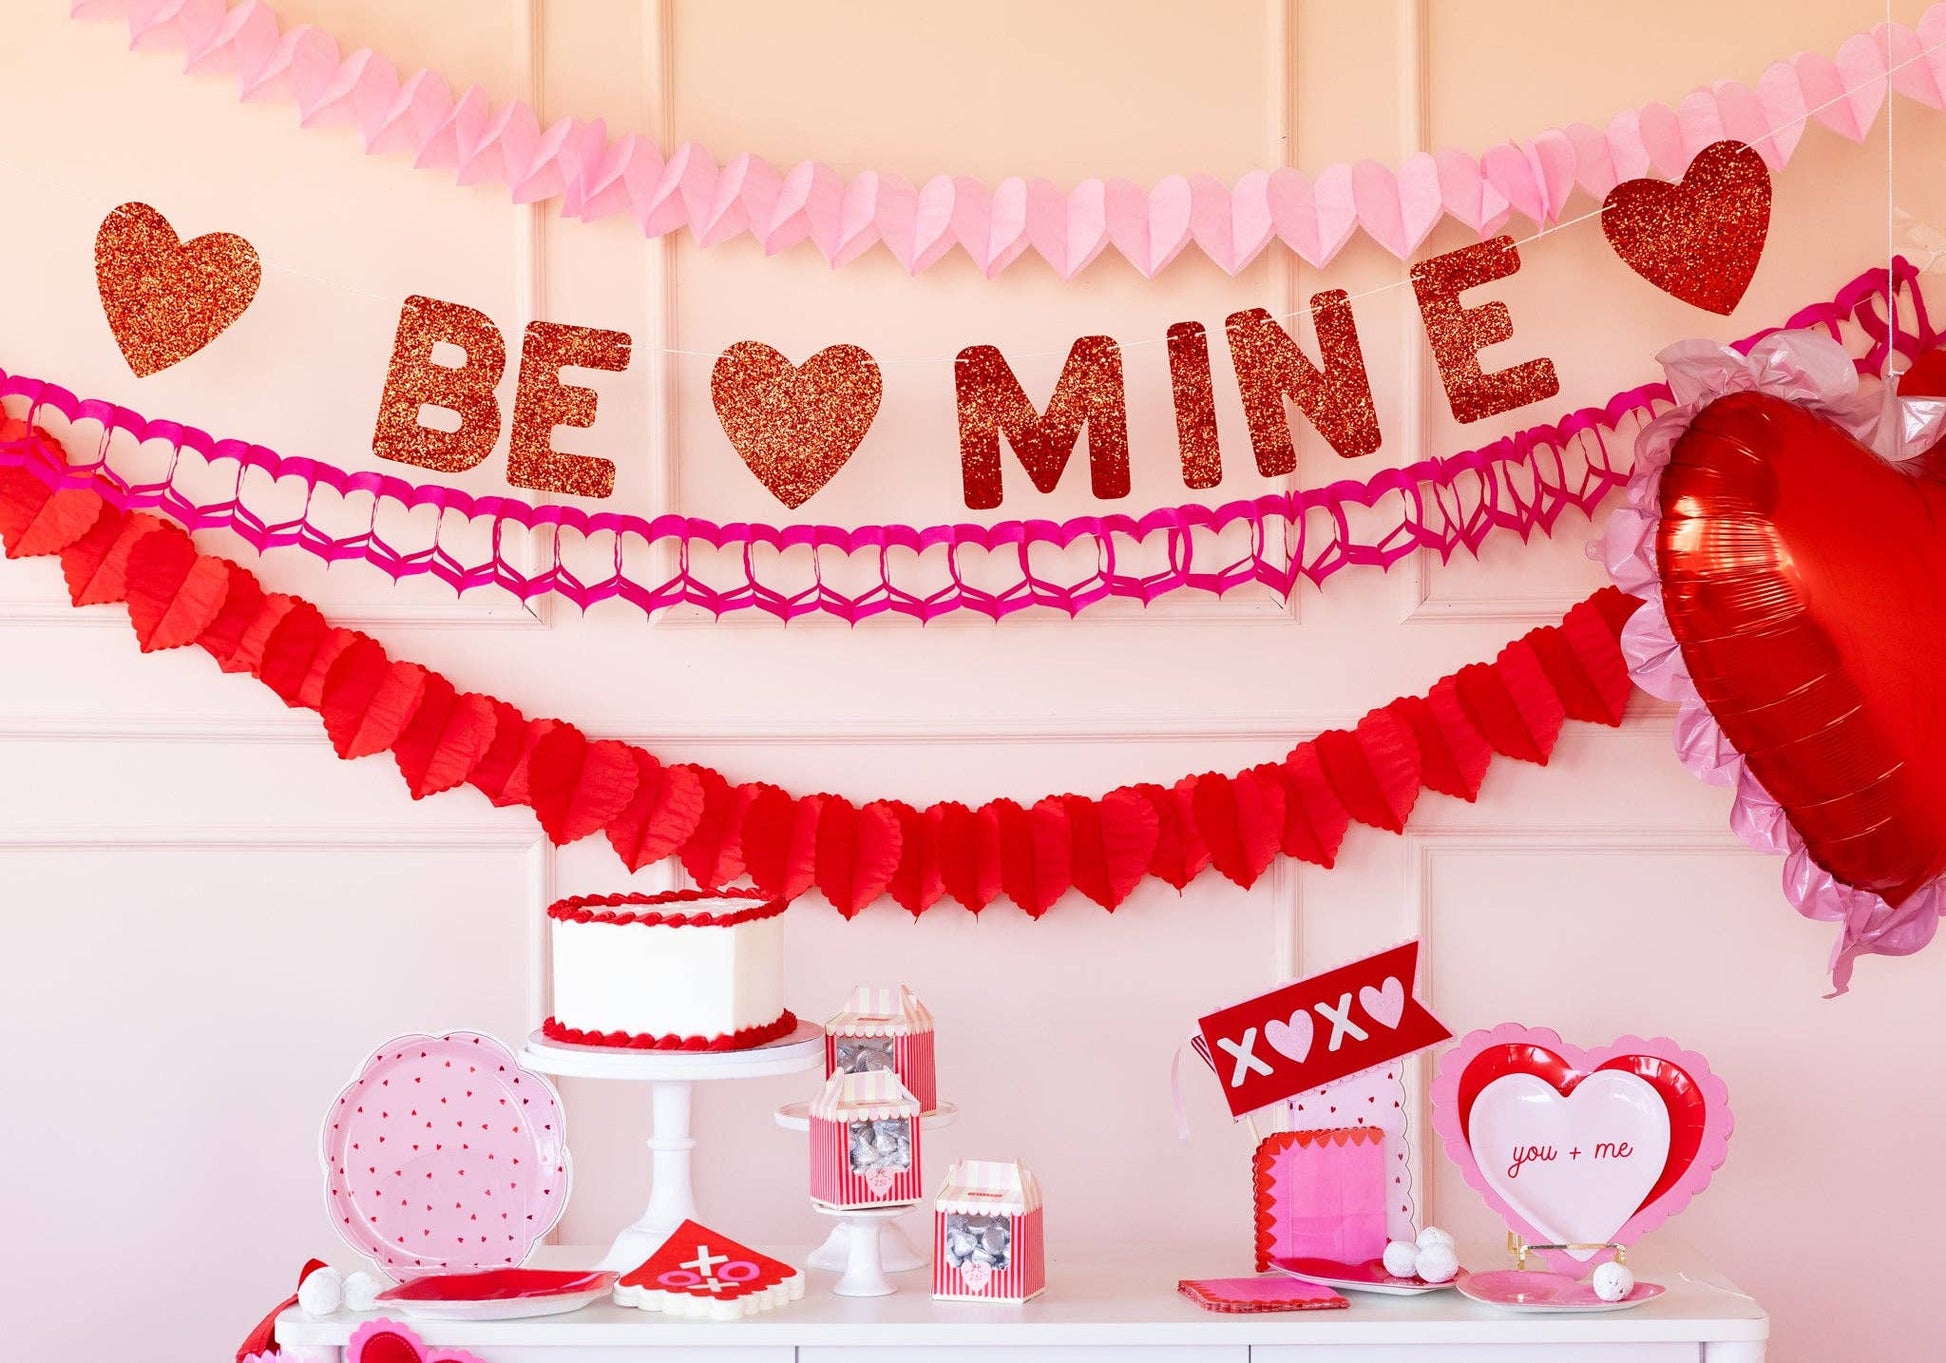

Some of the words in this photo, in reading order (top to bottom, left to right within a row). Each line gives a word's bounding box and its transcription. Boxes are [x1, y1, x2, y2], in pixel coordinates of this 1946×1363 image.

[372, 294, 632, 498] BE
[954, 235, 1560, 510] MINE
[1507, 1145, 1558, 1178] you
[1594, 1141, 1634, 1159] me
